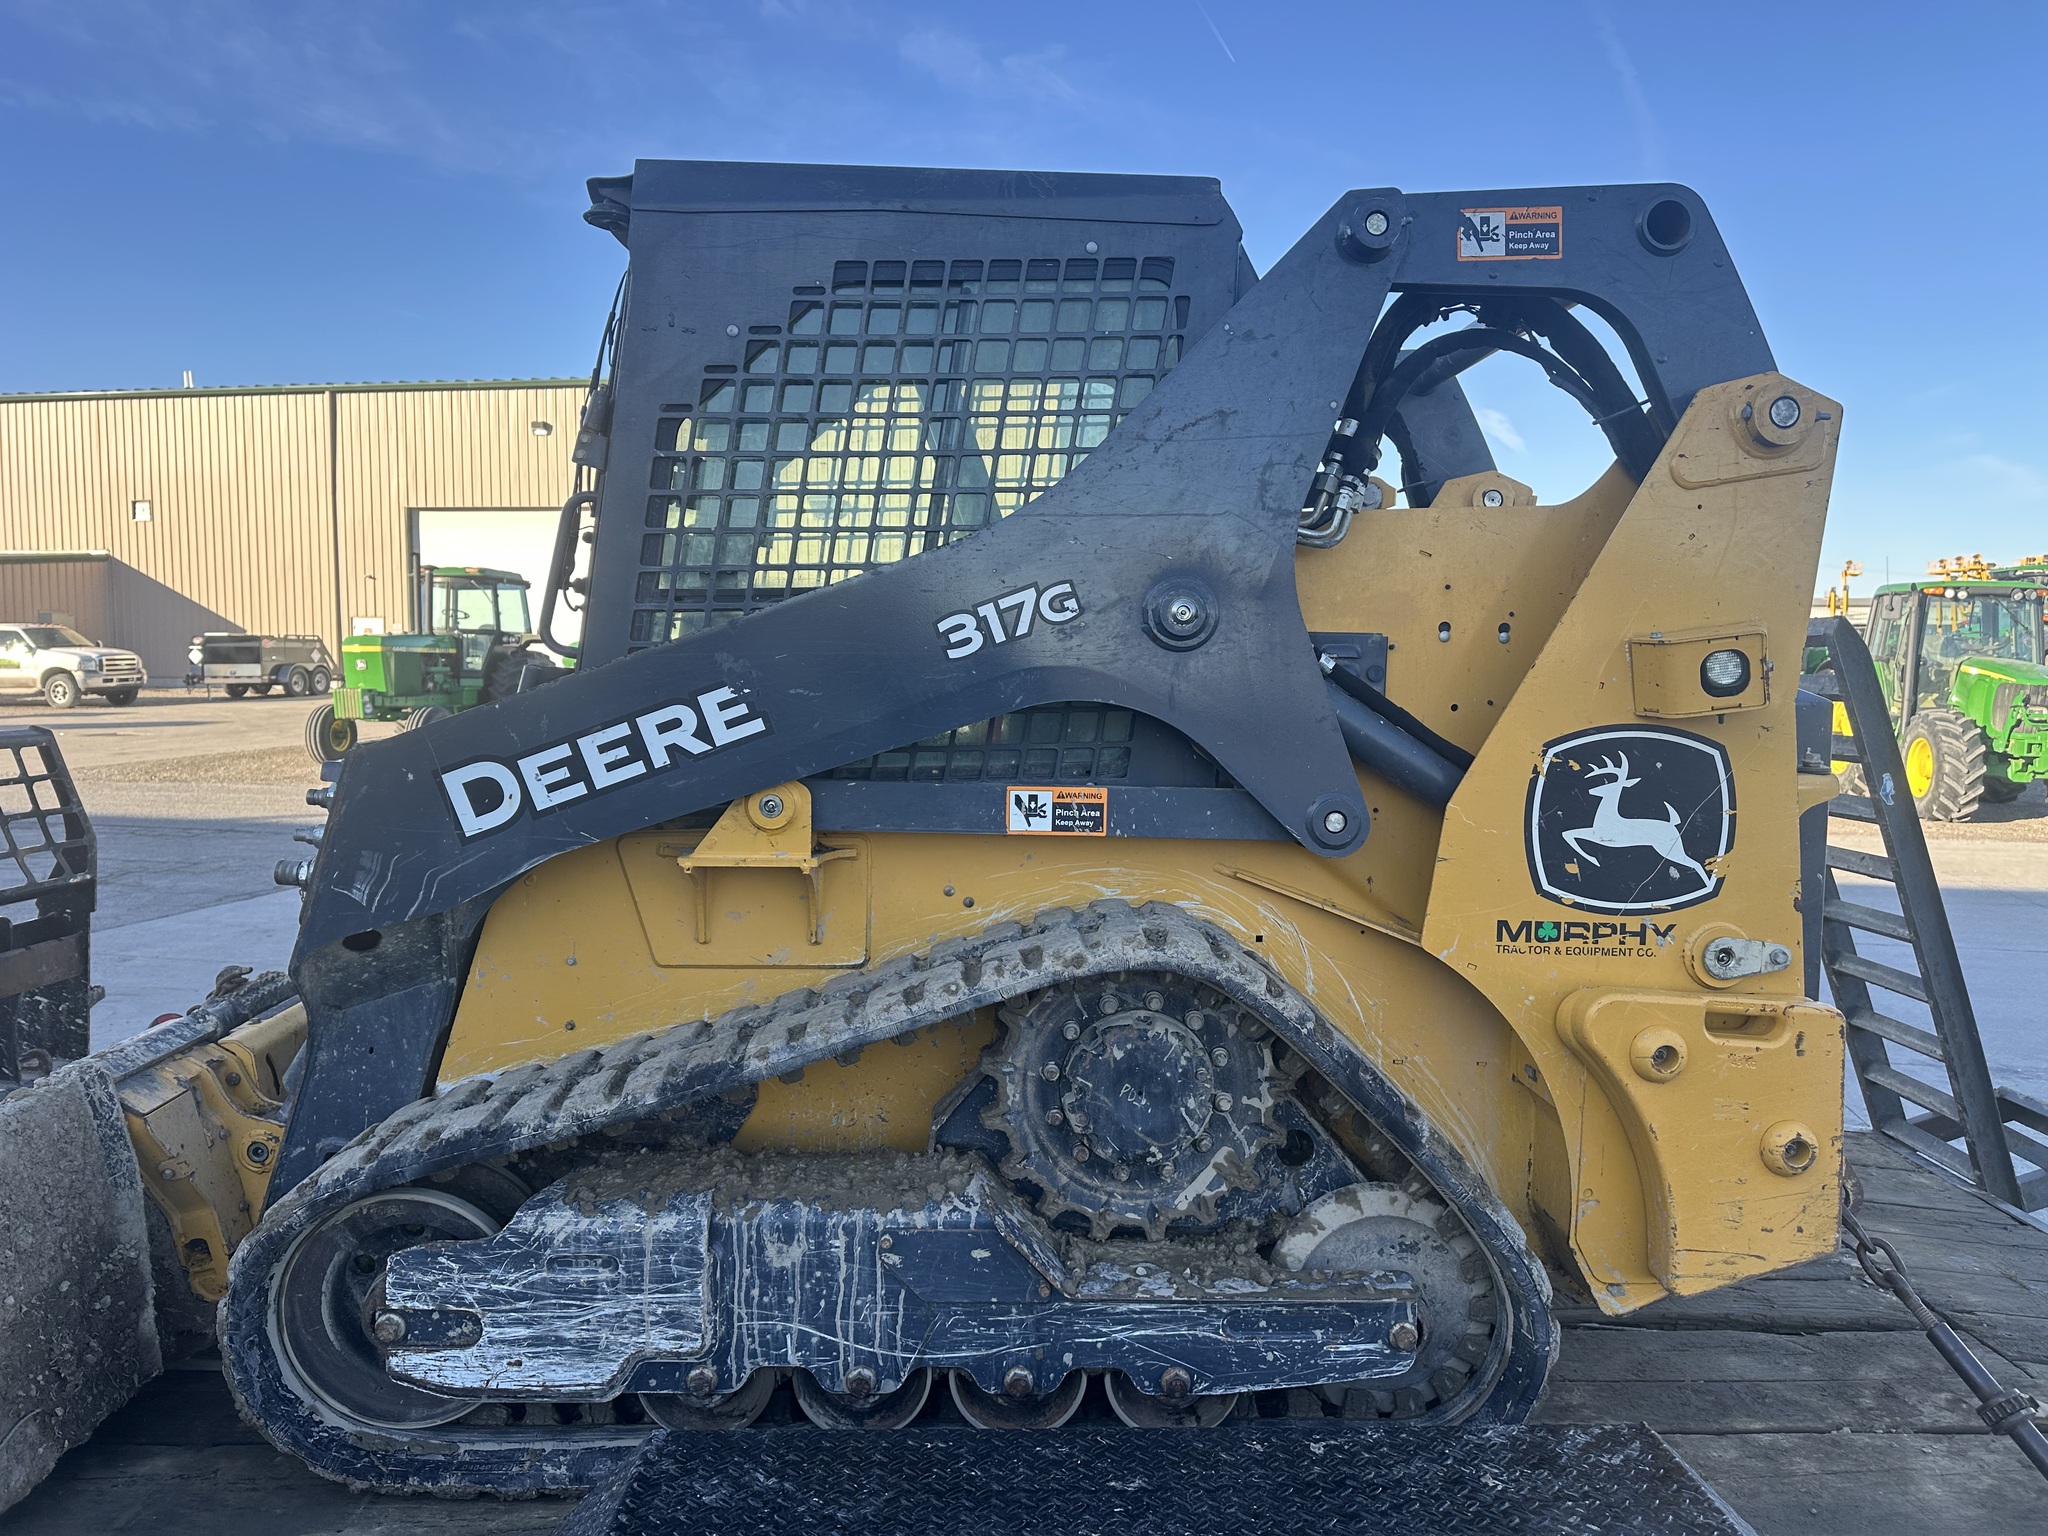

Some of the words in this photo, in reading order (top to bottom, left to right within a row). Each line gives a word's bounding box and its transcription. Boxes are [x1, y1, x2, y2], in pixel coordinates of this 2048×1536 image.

[1535, 230, 1556, 238] Area
[937, 583, 1080, 659] 317G
[441, 685, 767, 838] DEERE
[1055, 808, 1079, 817] Pinch
[1055, 819, 1074, 827] Keep
[1074, 819, 1094, 827] Away
[1496, 919, 1678, 946] MURPHY
[1495, 944, 1551, 955] TRACTOR
[1554, 946, 1562, 956] &
[1565, 946, 1635, 957] EQUIPMENT
[1636, 948, 1657, 958] CO.
